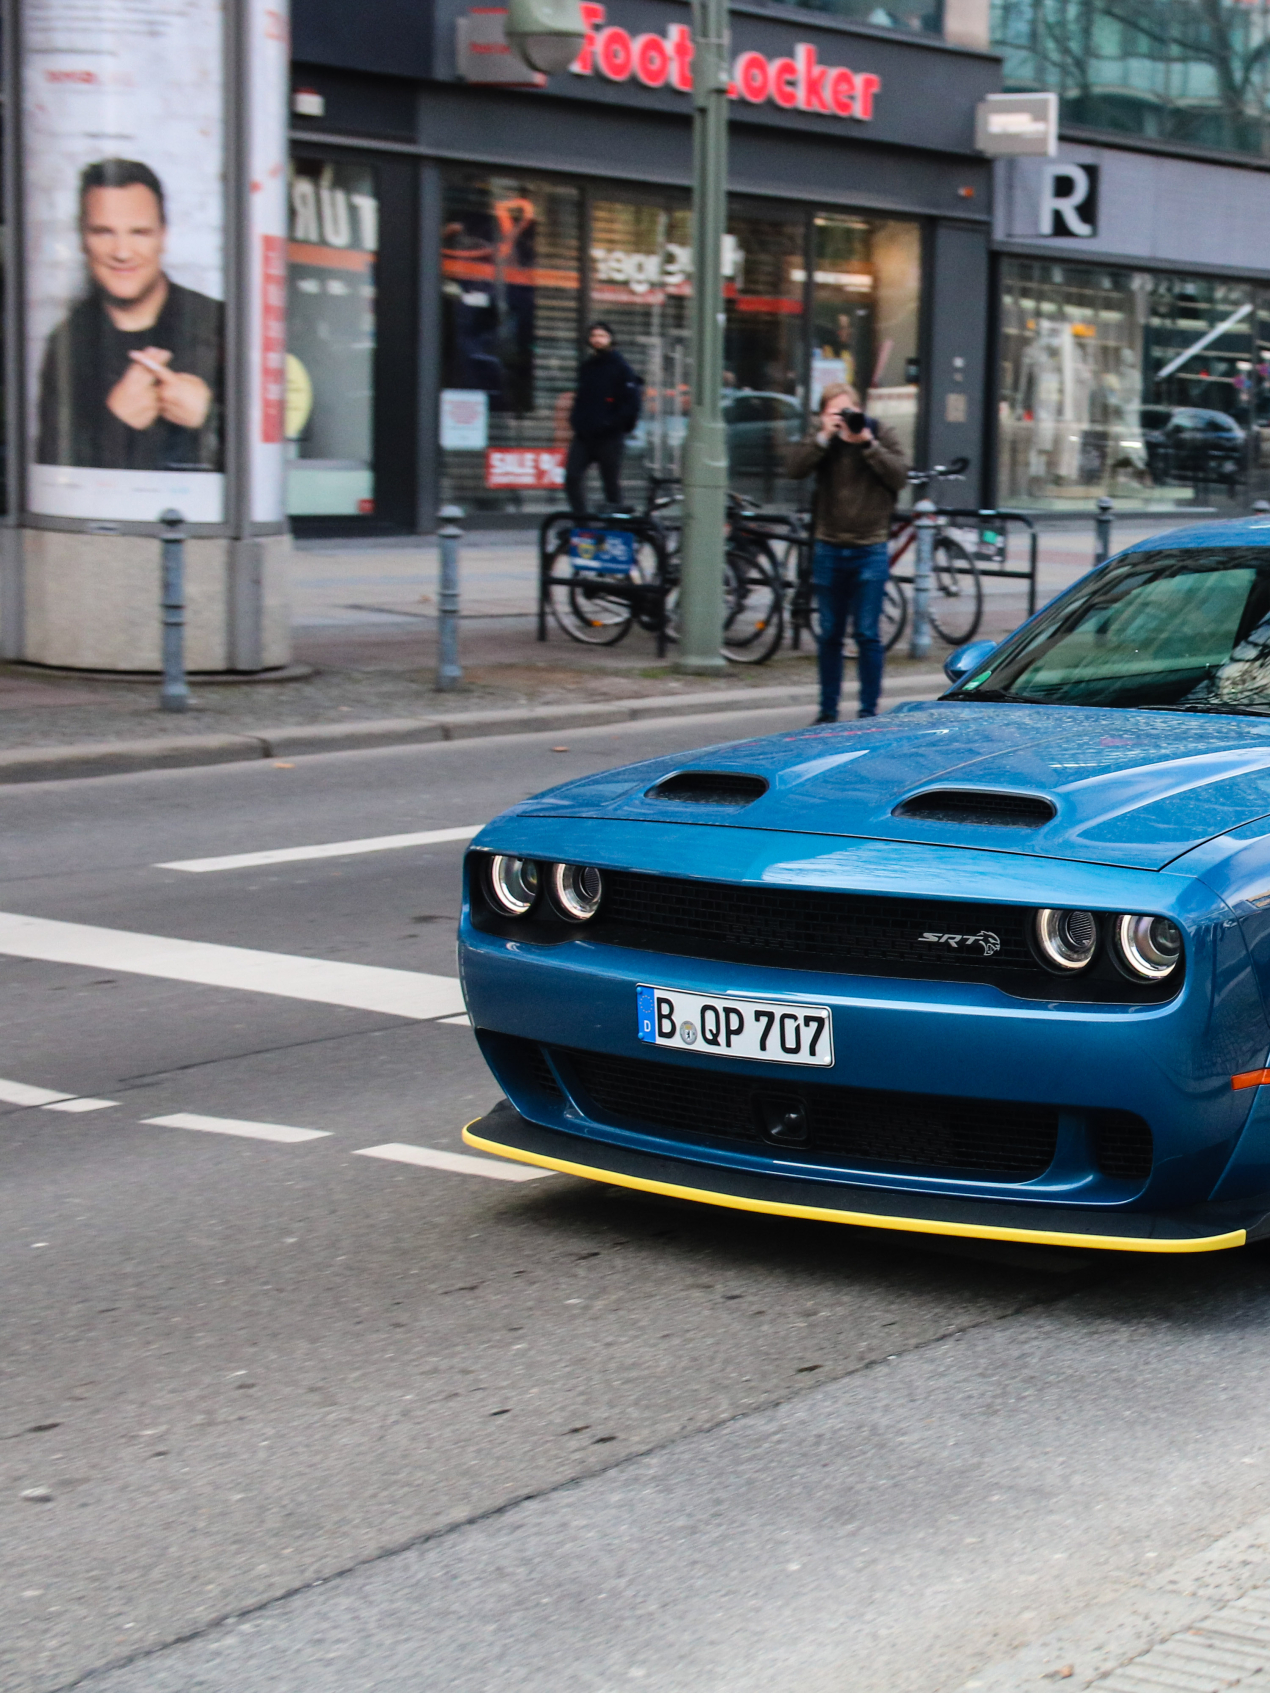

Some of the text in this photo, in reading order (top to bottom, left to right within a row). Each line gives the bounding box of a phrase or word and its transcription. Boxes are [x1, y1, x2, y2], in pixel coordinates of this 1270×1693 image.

[569, 1, 880, 121] Foot ocker
[1039, 163, 1094, 237] R
[490, 452, 537, 473] SALE
[918, 931, 984, 948] SRT
[643, 1019, 652, 1033] D
[656, 997, 826, 1057] B QP 707
